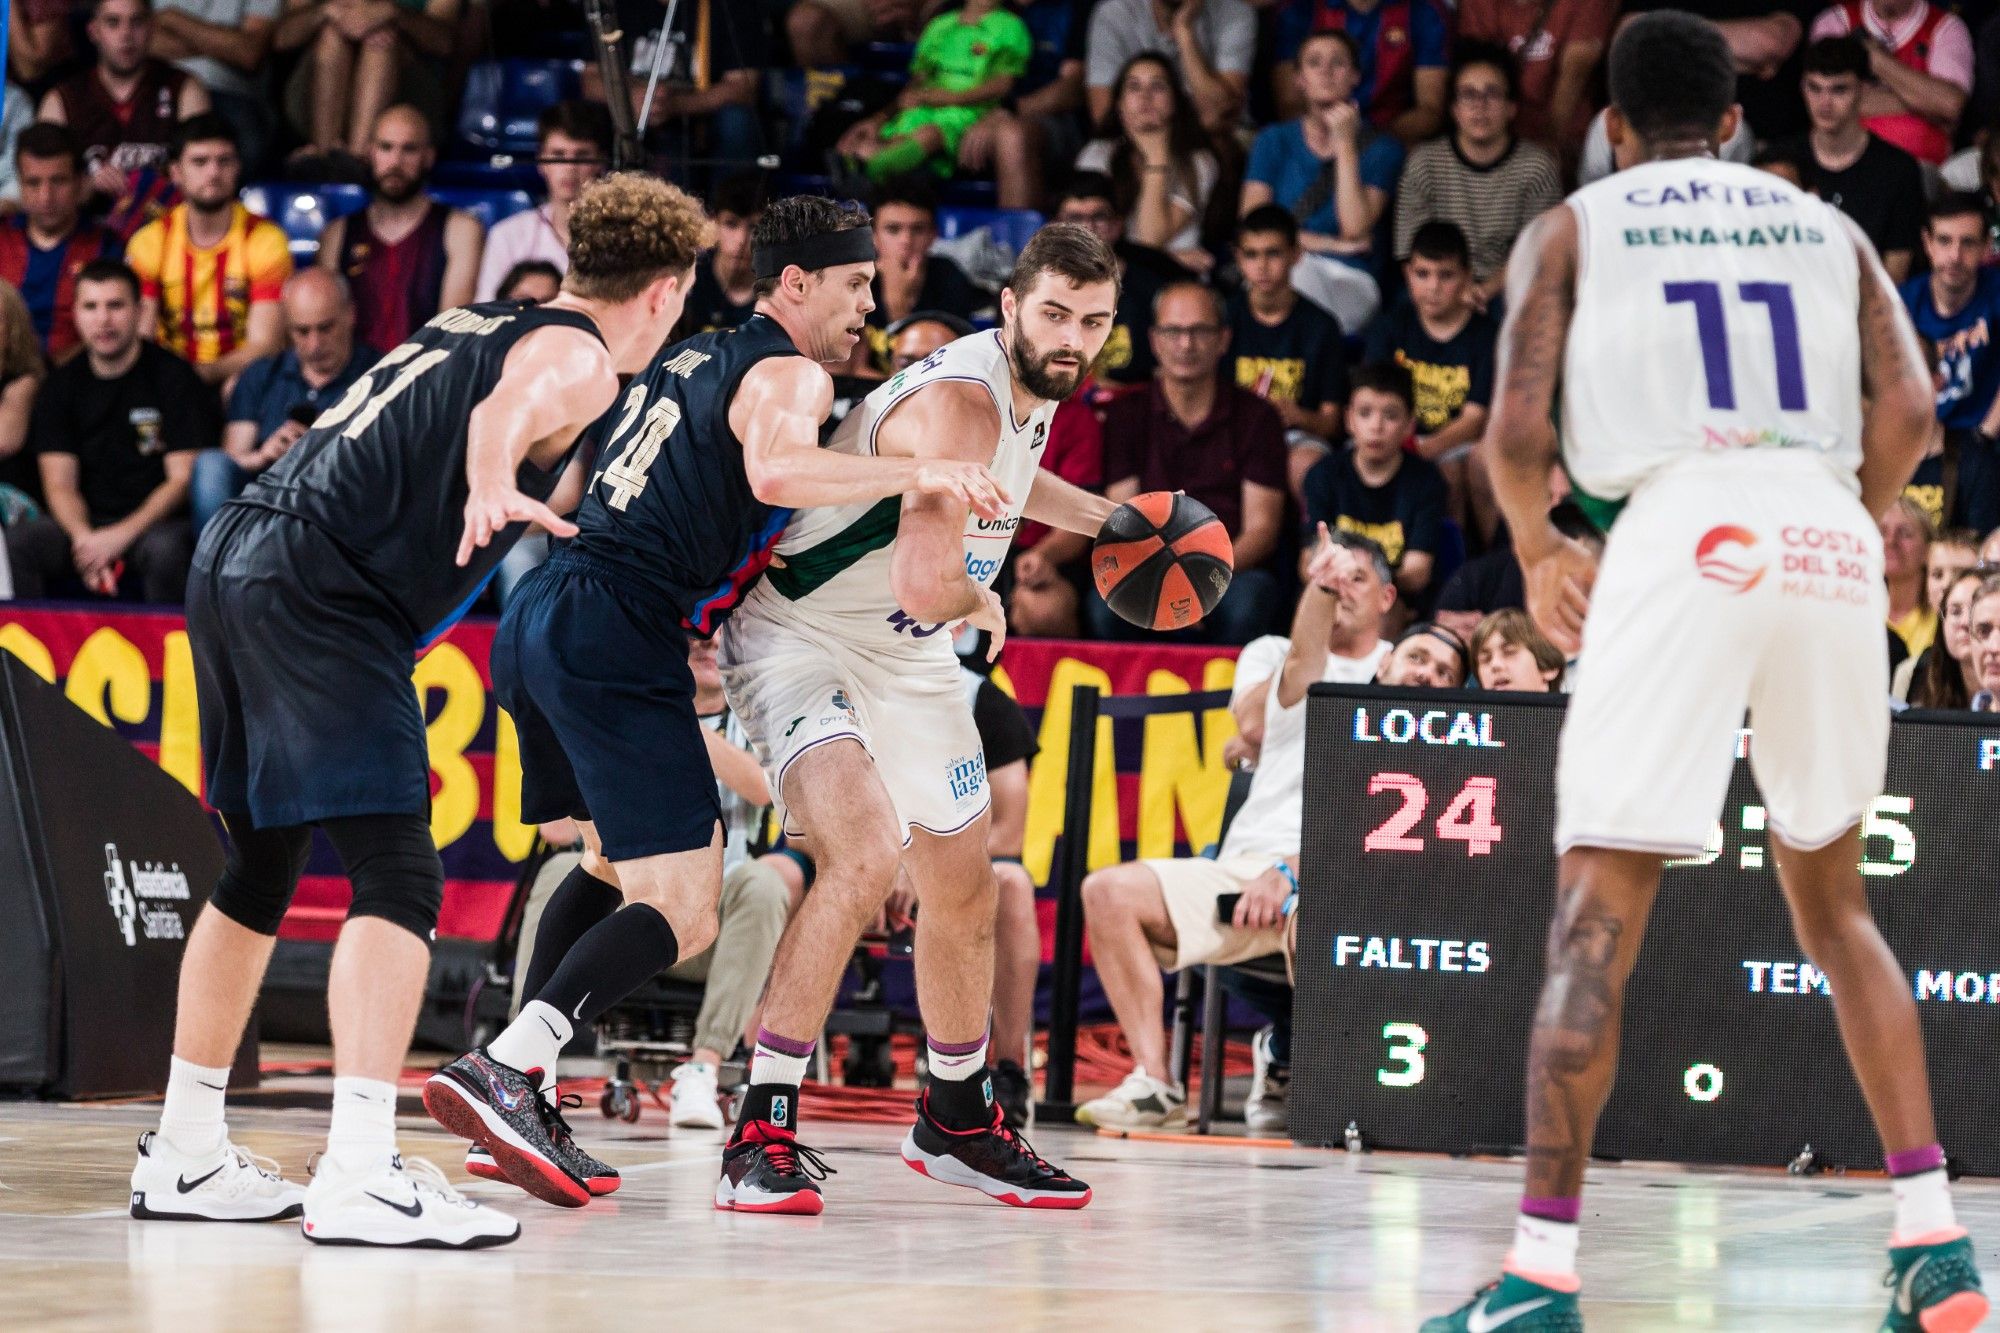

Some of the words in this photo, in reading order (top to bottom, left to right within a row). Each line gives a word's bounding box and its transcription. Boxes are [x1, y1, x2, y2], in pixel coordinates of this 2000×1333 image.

[1626, 179, 1793, 207] CARTER
[1624, 221, 1825, 246] BENAHAVÍS
[1664, 279, 1808, 412] 11
[1782, 526, 1868, 555] COSTA
[1784, 554, 1830, 576] DEL
[1836, 559, 1871, 584] SOL
[1353, 707, 1505, 747] LOCAL
[1365, 771, 1503, 858] 24
[1335, 935, 1492, 974] FALTES
[1377, 1021, 1430, 1088] 3
